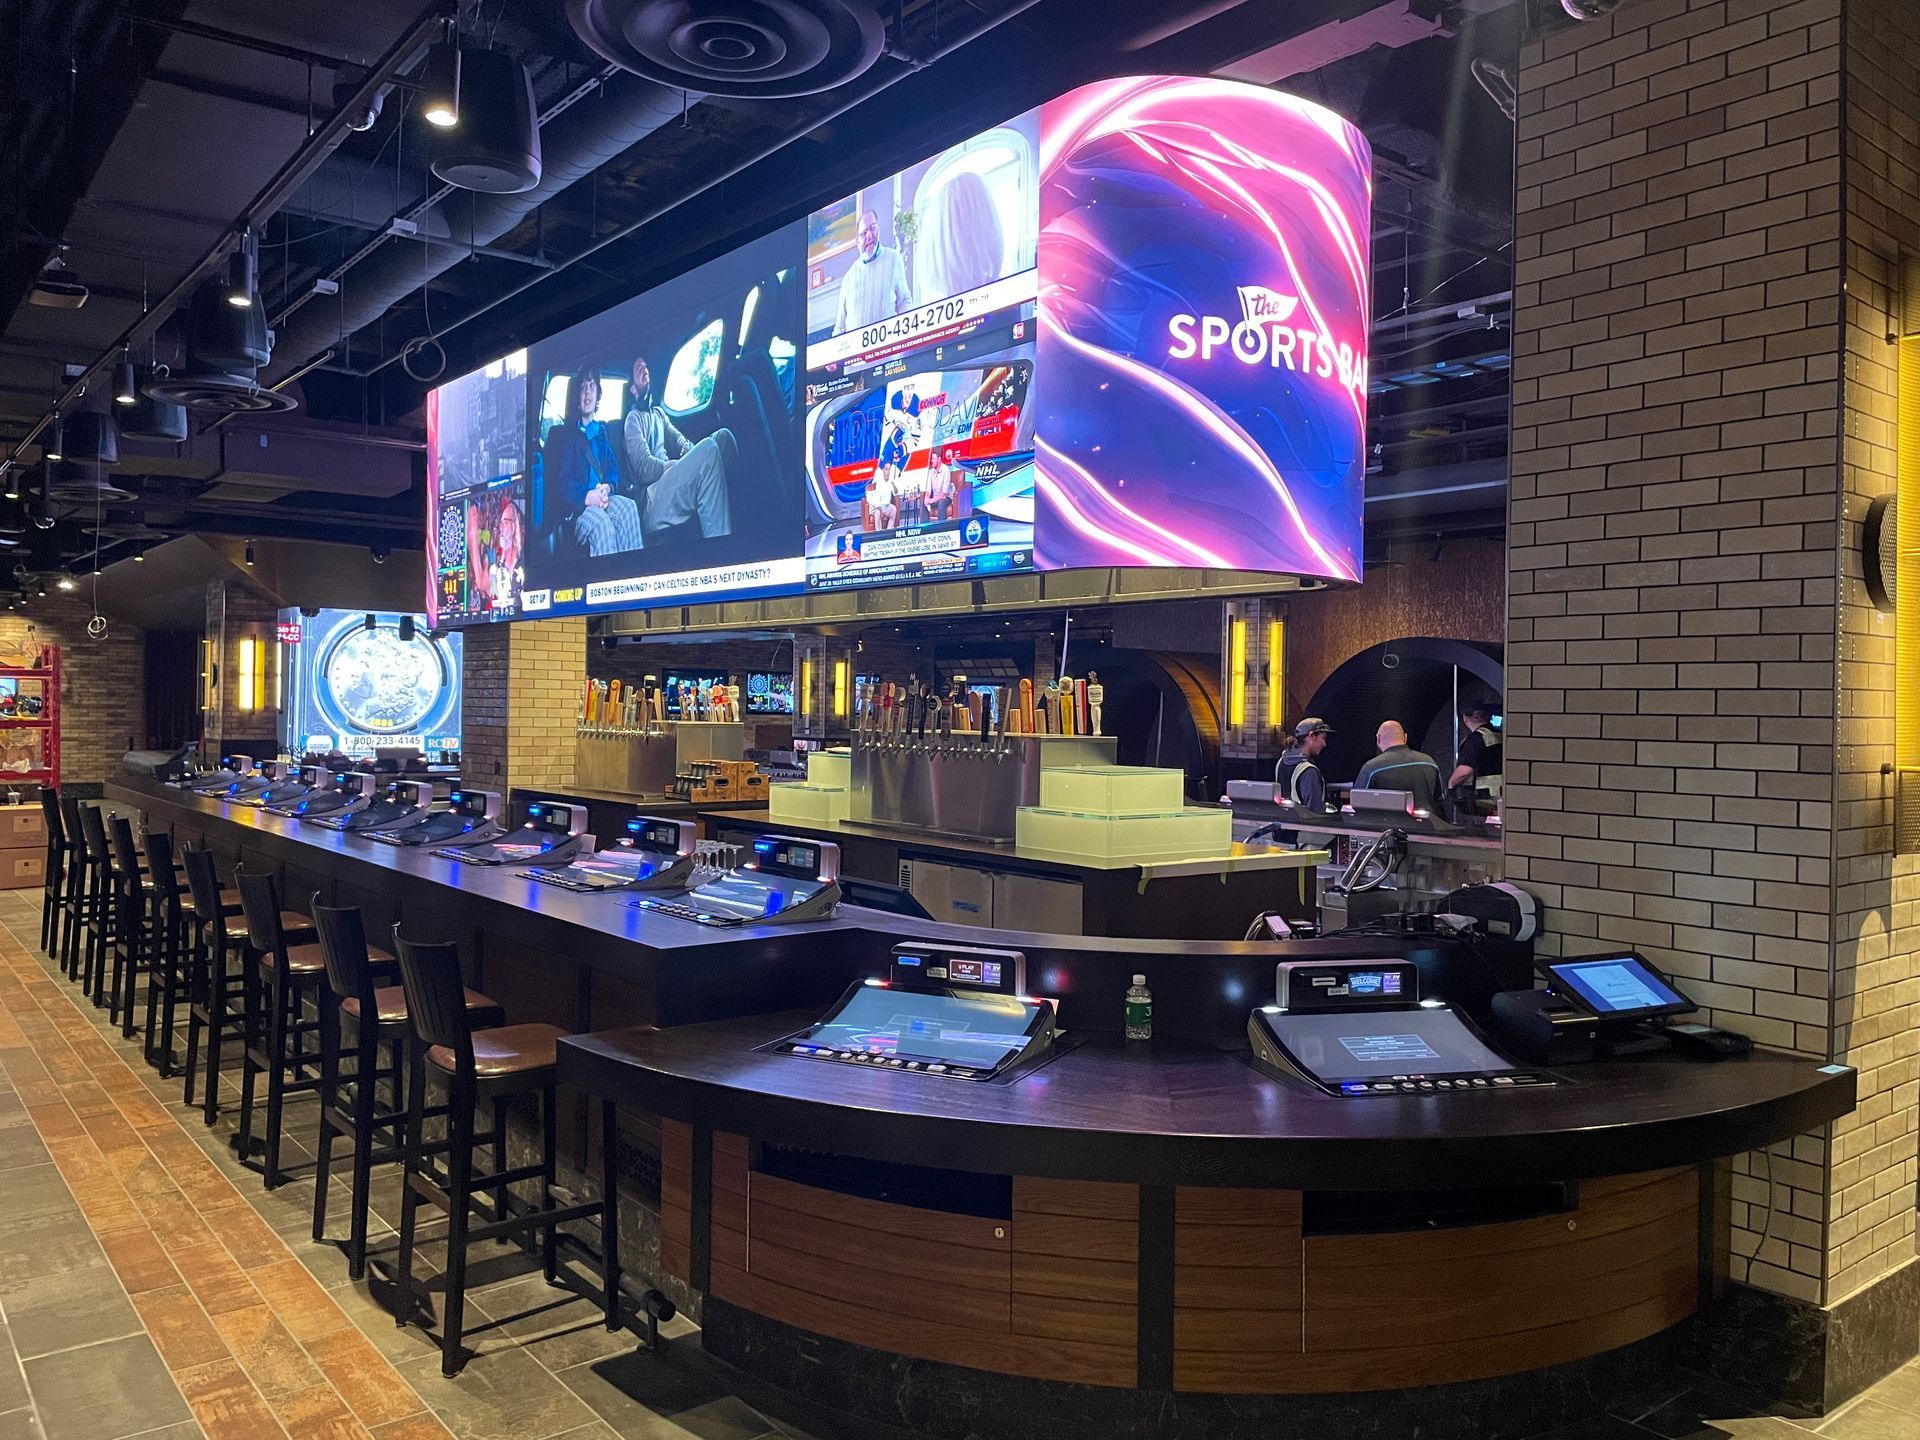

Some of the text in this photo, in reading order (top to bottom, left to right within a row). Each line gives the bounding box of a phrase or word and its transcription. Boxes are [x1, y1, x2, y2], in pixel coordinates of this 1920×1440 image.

[1251, 293, 1280, 317] the
[861, 298, 965, 348] 800-434-2702
[885, 360, 902, 369] SEATTLE
[885, 367, 894, 376] LAS
[893, 365, 907, 374] VEGAS
[920, 395, 945, 410] CONNOR
[976, 464, 1000, 476] NHL
[895, 528, 921, 538] NHL NOW
[443, 579, 458, 594] 441
[590, 568, 771, 598] BOSTON BEGINNING? CAN CELTICS BE NBA'S NEXT DYNASTY?
[529, 593, 546, 604] GET UP
[554, 588, 583, 603] COMING UP
[344, 736, 421, 746] 1-800-233-4145
